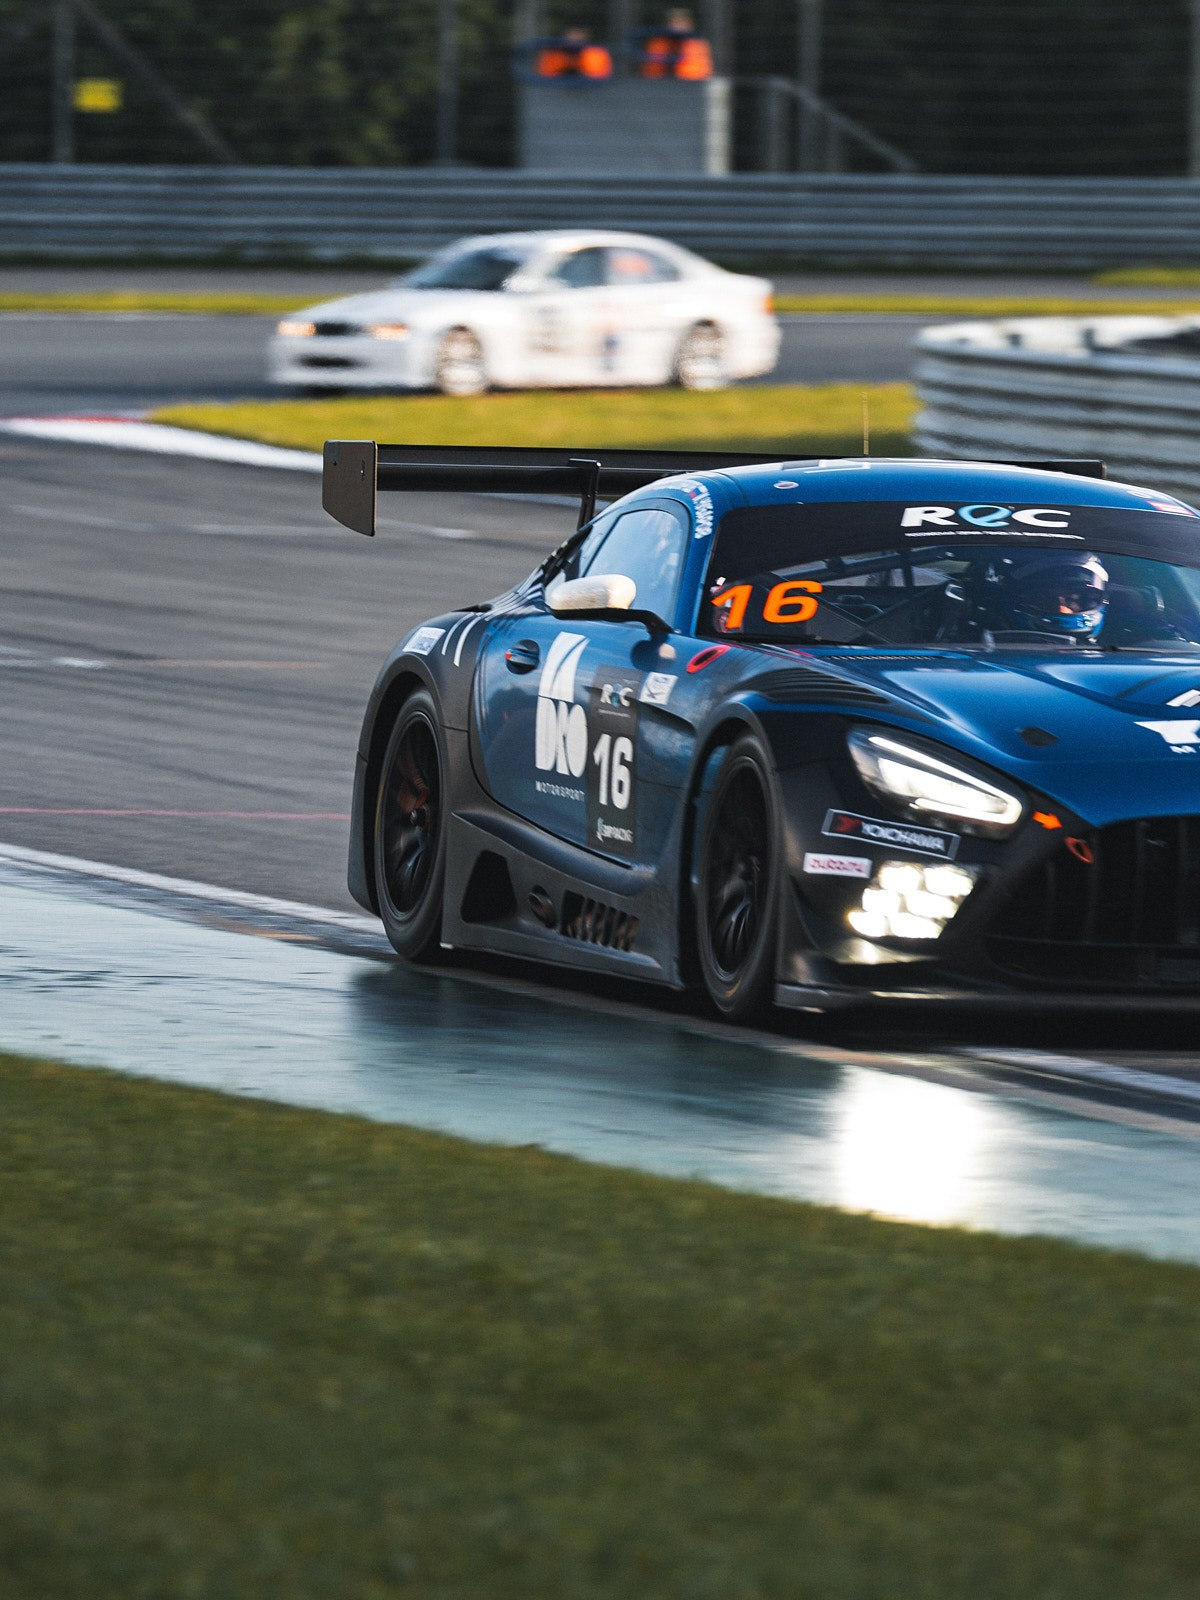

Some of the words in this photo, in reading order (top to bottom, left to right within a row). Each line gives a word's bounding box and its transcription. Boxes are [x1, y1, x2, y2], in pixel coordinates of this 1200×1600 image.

[710, 579, 823, 630] 16
[535, 780, 585, 802] MOTORSPORT
[593, 733, 634, 811] 16
